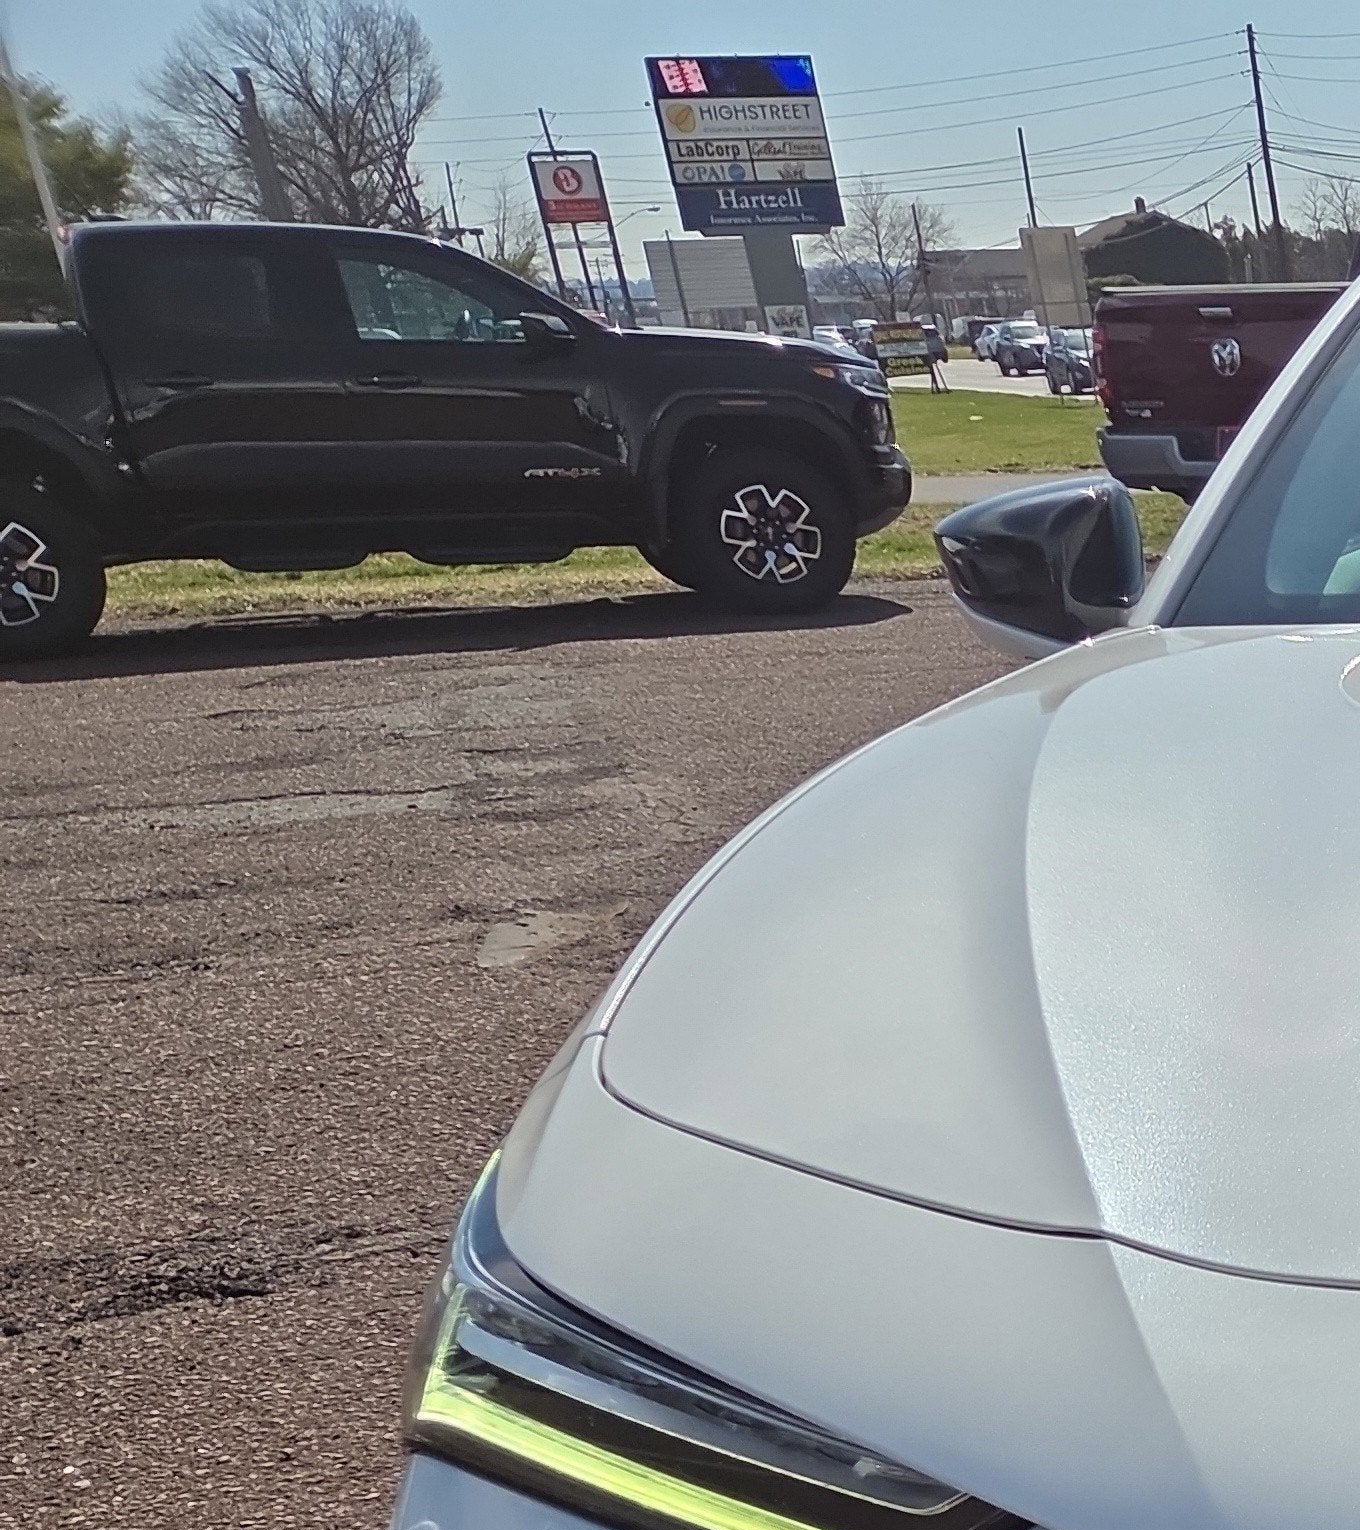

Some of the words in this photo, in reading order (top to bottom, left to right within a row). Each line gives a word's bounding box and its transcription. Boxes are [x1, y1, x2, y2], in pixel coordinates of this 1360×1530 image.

[699, 103, 812, 121] HIGHSTREET
[676, 142, 741, 160] LabCorp
[716, 187, 803, 210] Hartzell
